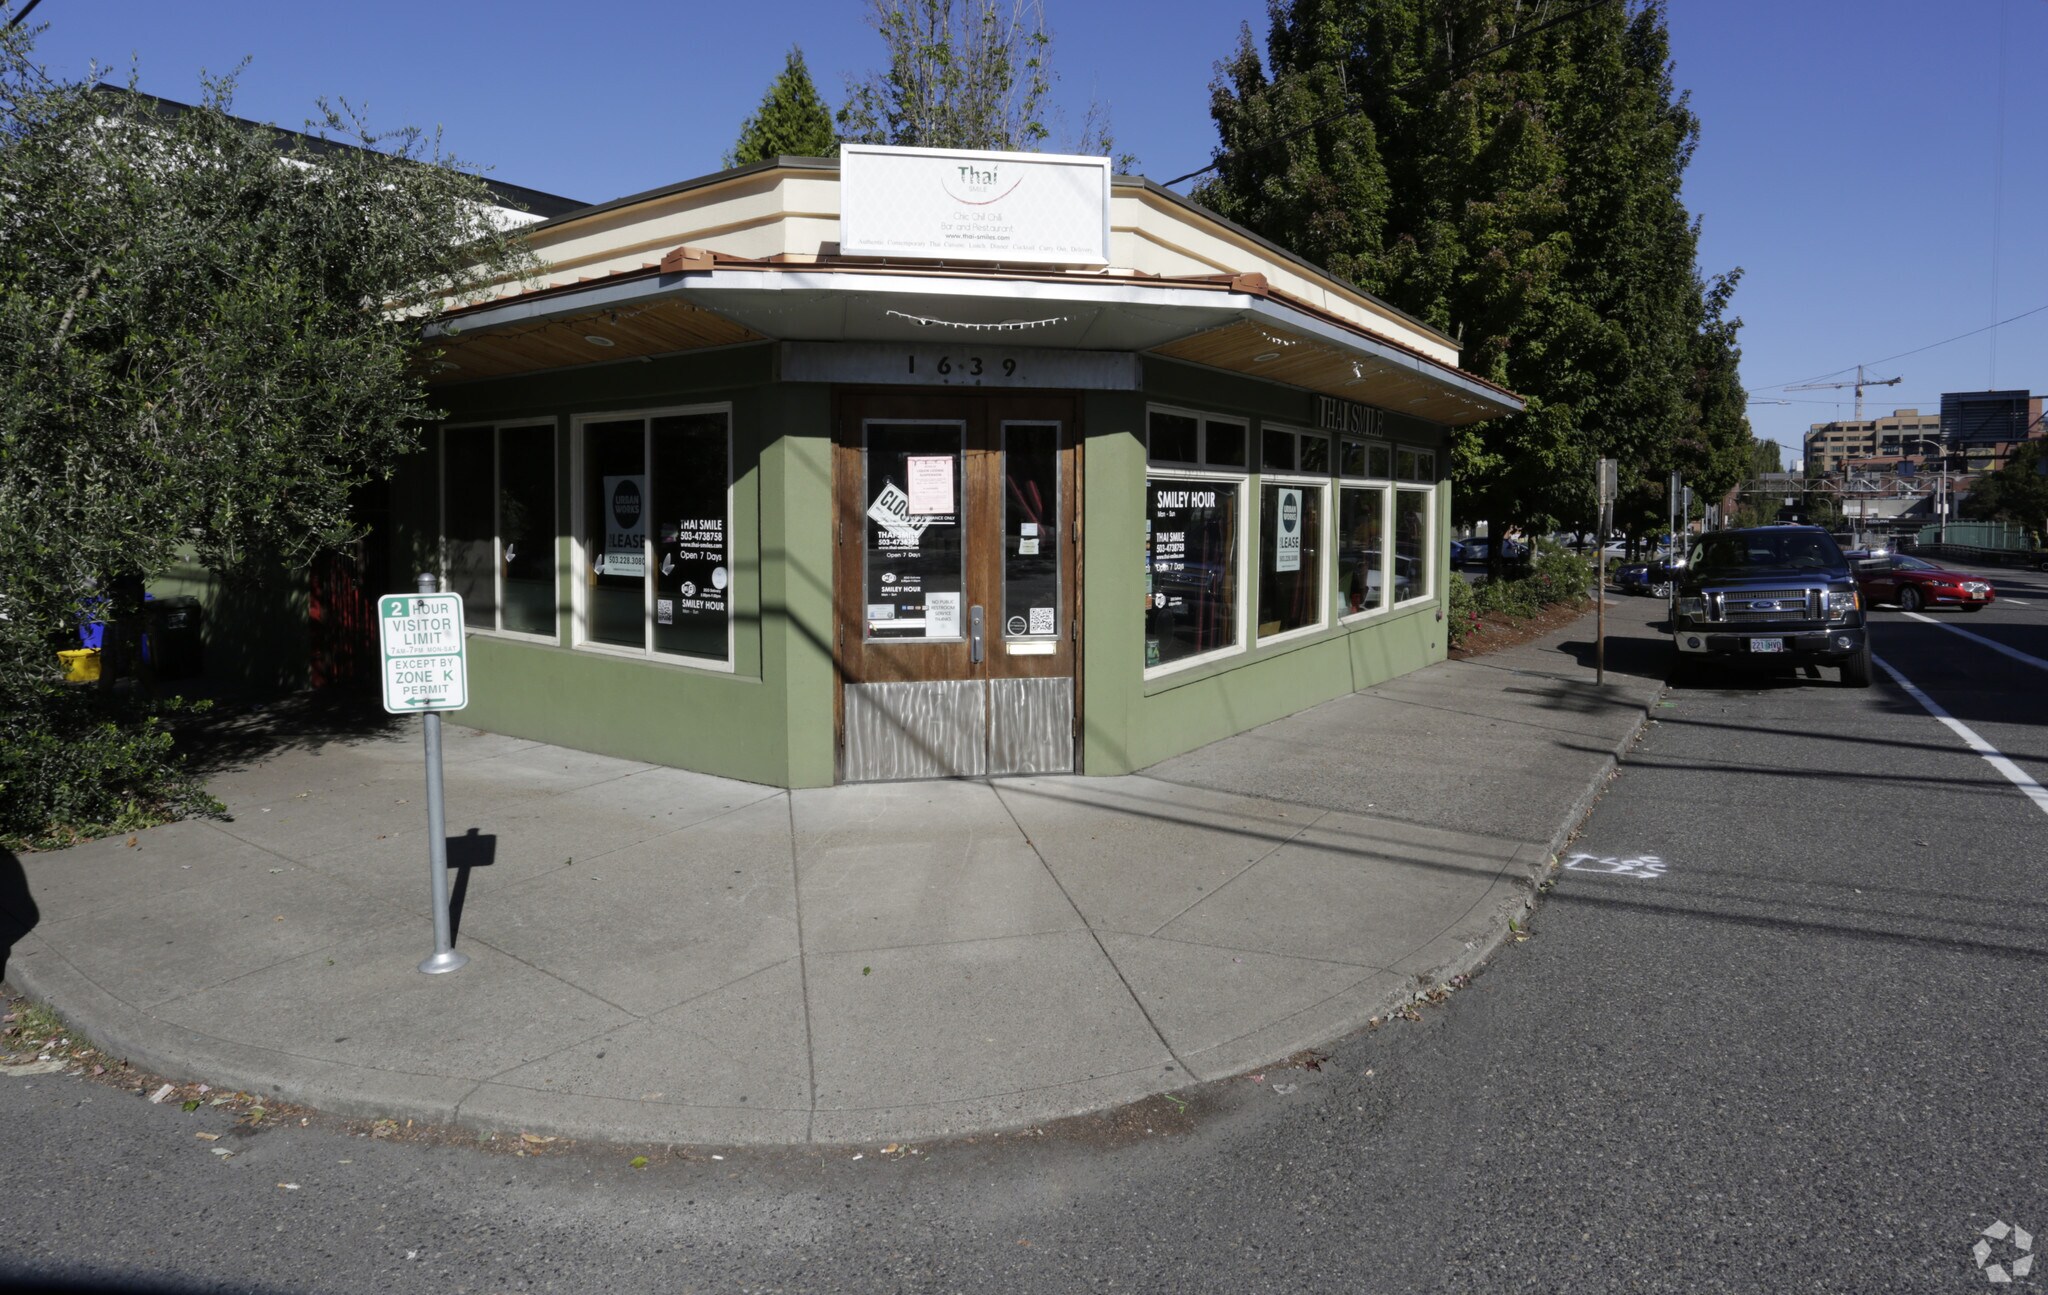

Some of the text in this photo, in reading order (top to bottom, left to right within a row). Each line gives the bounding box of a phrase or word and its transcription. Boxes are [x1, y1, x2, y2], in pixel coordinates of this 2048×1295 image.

[958, 164, 998, 184] Thai
[953, 211, 969, 220] Chic
[941, 222, 1014, 232] Bar and Restaurant
[1320, 396, 1384, 438] THAI SMILE
[615, 495, 639, 504] URBAN
[1157, 490, 1216, 508] SMILEY HOUR
[614, 505, 640, 514] WORKS
[680, 520, 722, 530] THAI SMILE
[612, 533, 645, 548] LEASE
[680, 532, 722, 541] 503-4738758
[1156, 532, 1184, 543] THAI SMILE
[1281, 536, 1299, 548] LEASE
[680, 550, 722, 562] Open 7 Days
[391, 602, 449, 616] 2 HOUR
[682, 599, 724, 611] SMILEY HOUR
[393, 618, 451, 632] VISITOR
[404, 632, 442, 645] LIMIT
[395, 658, 454, 670] EXCEPT BY
[396, 670, 454, 684] ZONE K
[403, 684, 449, 695] PERMIT
